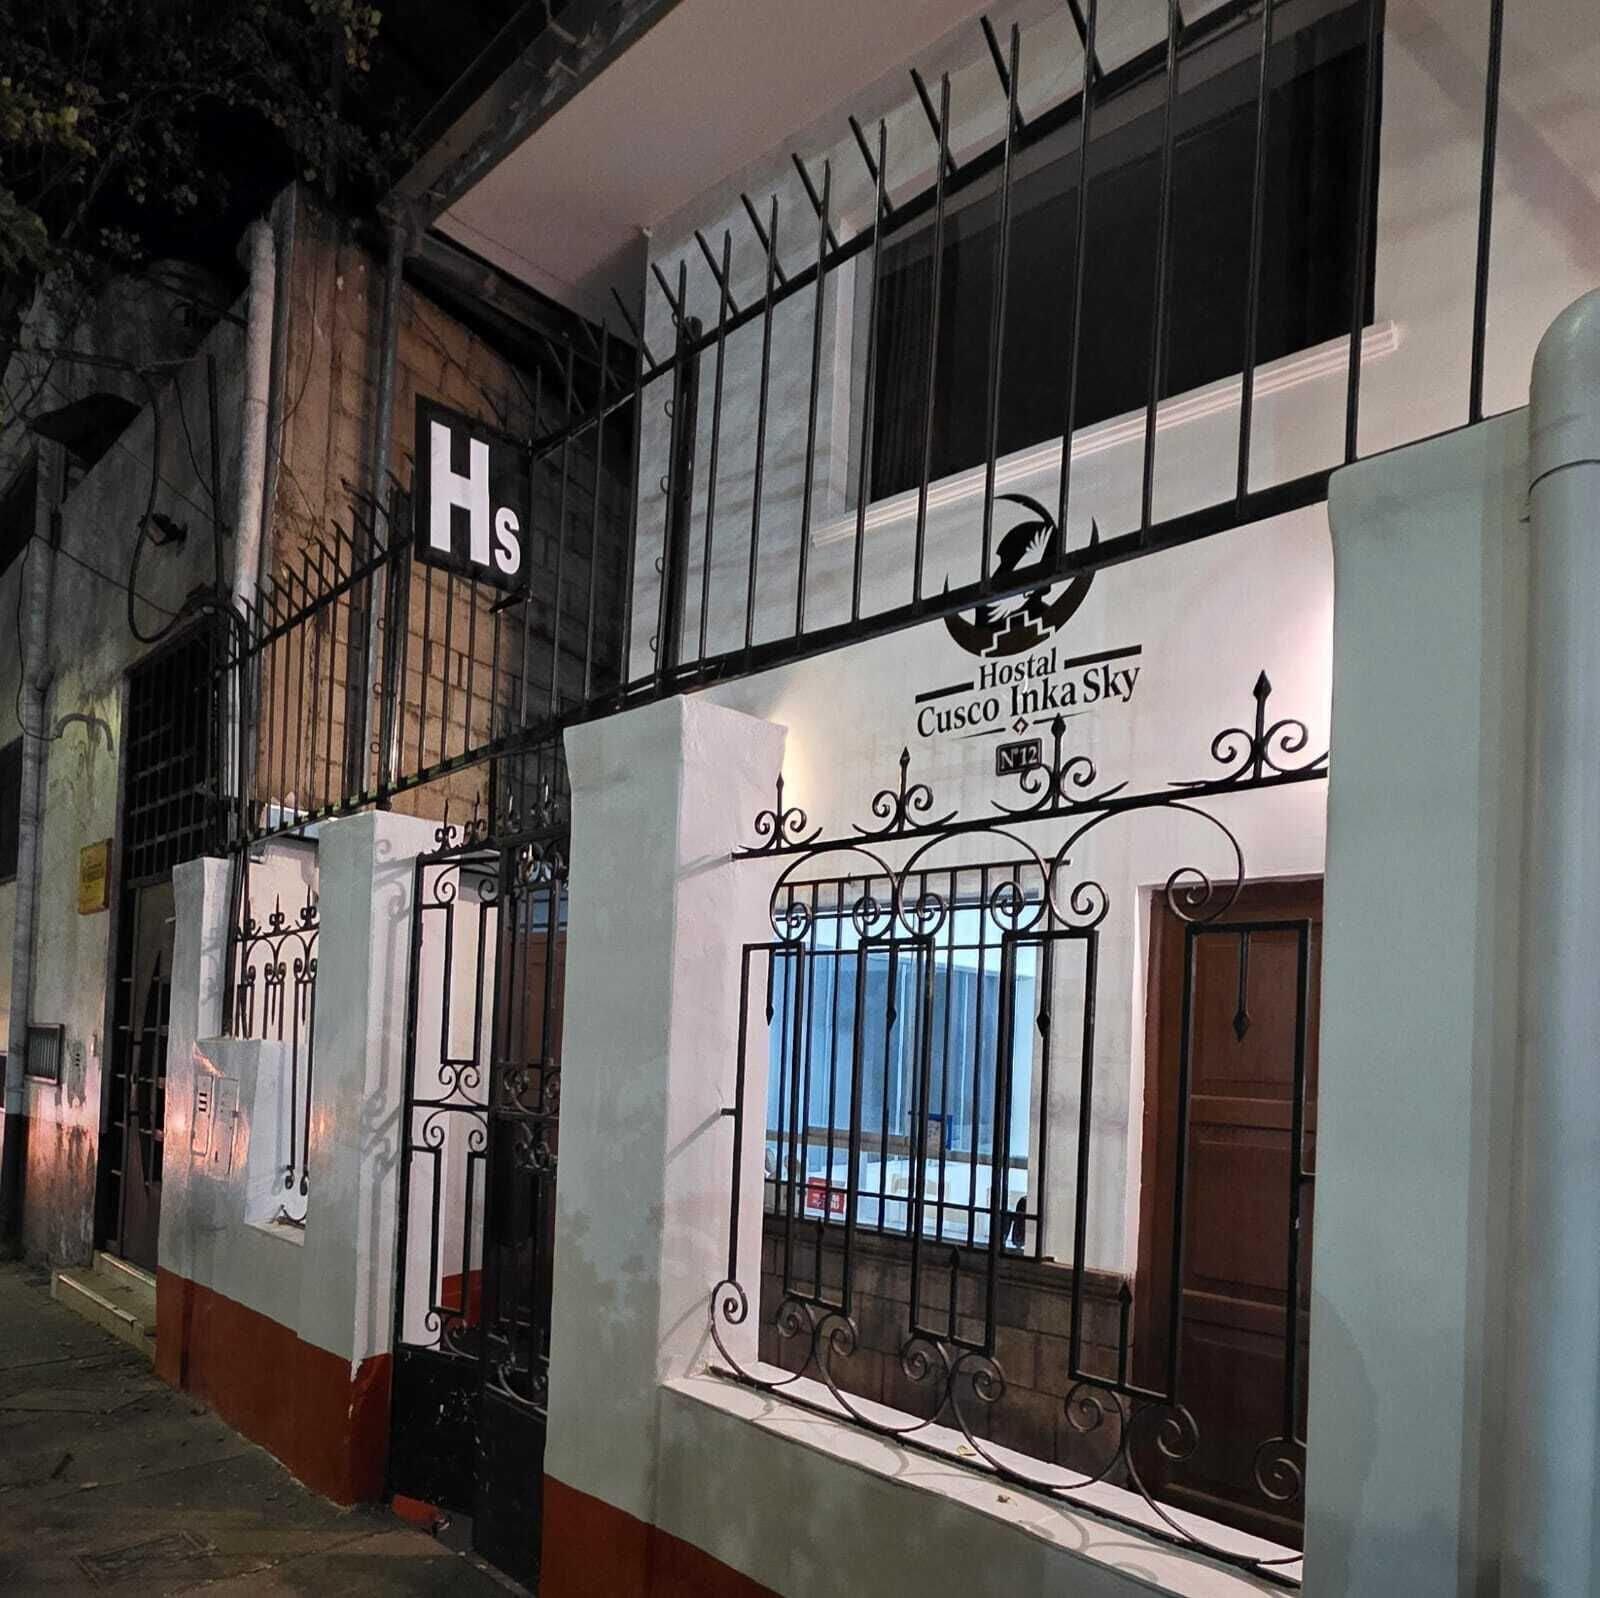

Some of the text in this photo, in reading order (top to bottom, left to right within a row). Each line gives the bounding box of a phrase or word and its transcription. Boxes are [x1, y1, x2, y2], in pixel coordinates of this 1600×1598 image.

[430, 420, 521, 575] Hs
[917, 664, 1140, 737] Cusco Inka Sky
[979, 647, 1057, 690] Hostal
